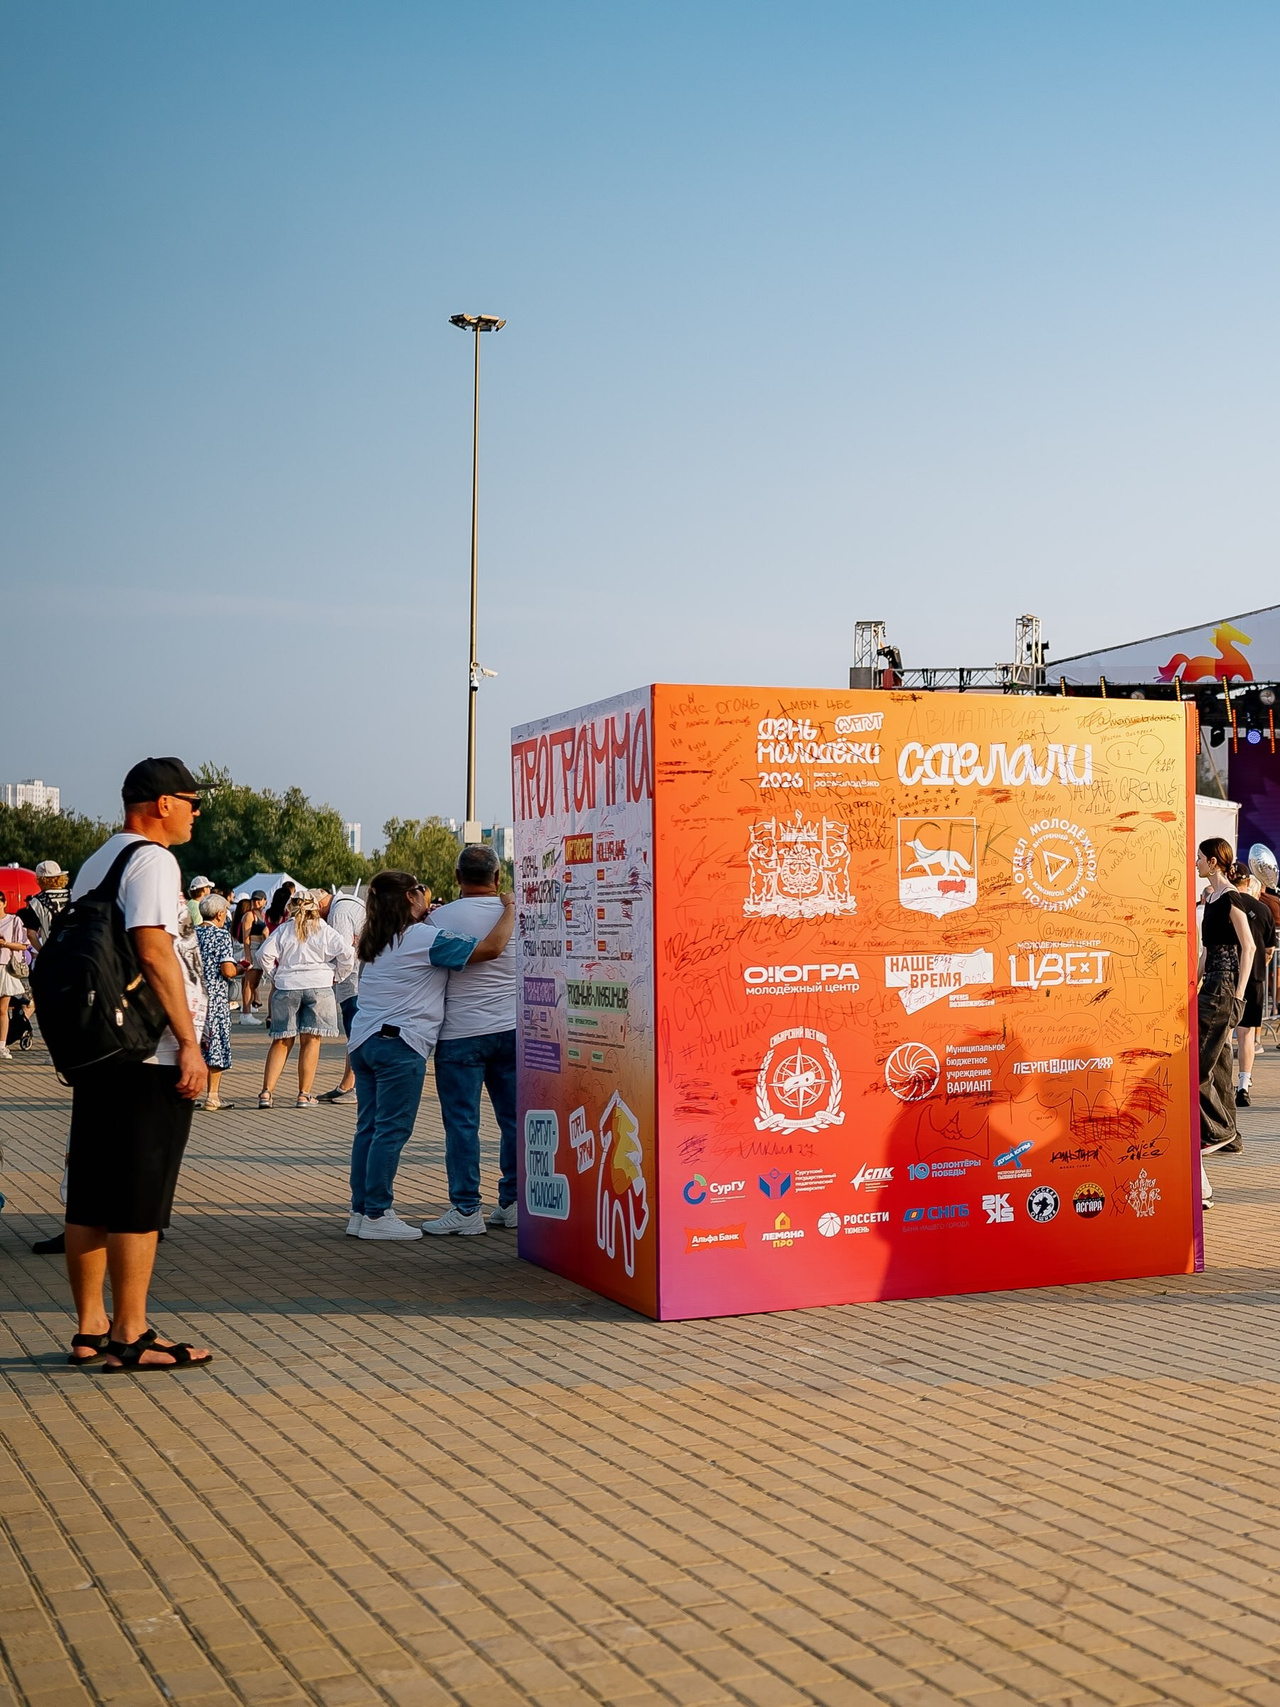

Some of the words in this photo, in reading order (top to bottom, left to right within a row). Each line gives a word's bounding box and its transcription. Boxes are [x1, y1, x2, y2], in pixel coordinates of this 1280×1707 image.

[758, 772, 804, 788] 2026
[1013, 837, 1028, 884] ОТДЕЛ
[1022, 886, 1089, 911] ПОЛИТИКИ
[1076, 940, 1101, 948] ЦЕНТР
[890, 956, 934, 972] НАШЕ
[1008, 951, 1111, 990] ЦВЕТ
[743, 963, 860, 984] О!ЮГРА
[910, 972, 961, 988] ВРЕМЯ
[746, 982, 822, 996] молодёжный
[825, 982, 860, 994] центр
[770, 1026, 804, 1048] СИБИРСКИЙ
[946, 1043, 1006, 1055] Муниципальное
[946, 1057, 988, 1066] бюджетное
[946, 1069, 992, 1080] учреждение
[947, 1080, 992, 1094] ВАРИАНТ
[997, 1153, 1014, 1166] ДУША
[1014, 1143, 1031, 1155] ЮГРЫ
[529, 1150, 549, 1176] ГОРОД
[932, 1159, 981, 1170] ВОЛОНТЁРЫ
[795, 1168, 823, 1176] Сургутский
[864, 1167, 895, 1179] СПК
[932, 1168, 966, 1178] ПОБЕДЫ
[709, 1181, 745, 1195] СурГУ
[1029, 1187, 1057, 1200] РУССКАЯ
[530, 1181, 564, 1210] МОЛОДЫХ
[927, 1204, 969, 1219] СНГБ
[844, 1212, 889, 1225] РОССЕТИ
[762, 1230, 804, 1241] ЛЕМАНА
[844, 1226, 870, 1234] ТЮМЕНЬ
[691, 1235, 718, 1244] Альфа
[719, 1233, 739, 1241] Банк
[772, 1240, 794, 1248] ПРО
